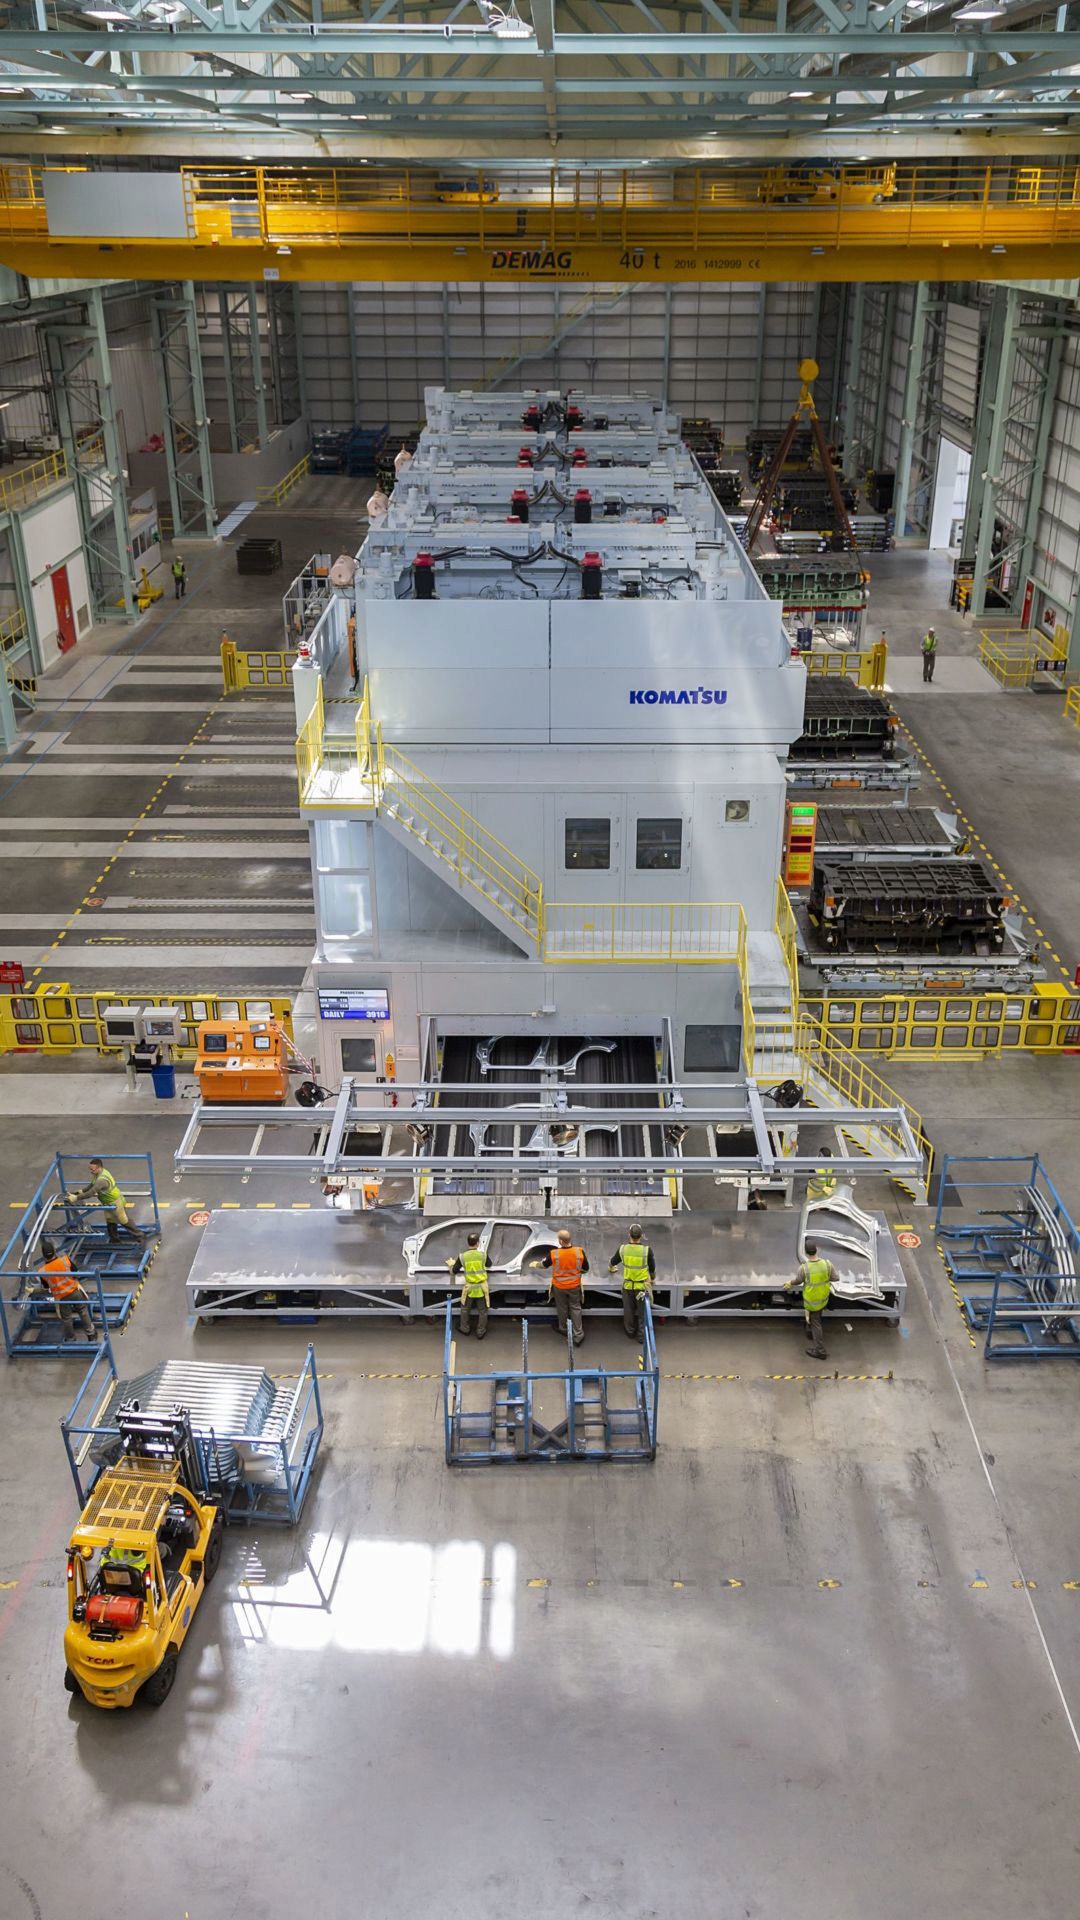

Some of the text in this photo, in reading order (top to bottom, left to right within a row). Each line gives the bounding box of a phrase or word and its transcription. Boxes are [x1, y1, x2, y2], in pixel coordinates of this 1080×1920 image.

[491, 251, 573, 269] DEMAG
[619, 252, 660, 269] 40 t
[674, 259, 697, 269] 2016
[629, 687, 728, 705] KOMATSU
[323, 1011, 345, 1019] DAILY
[86, 1655, 115, 1665] TCM
